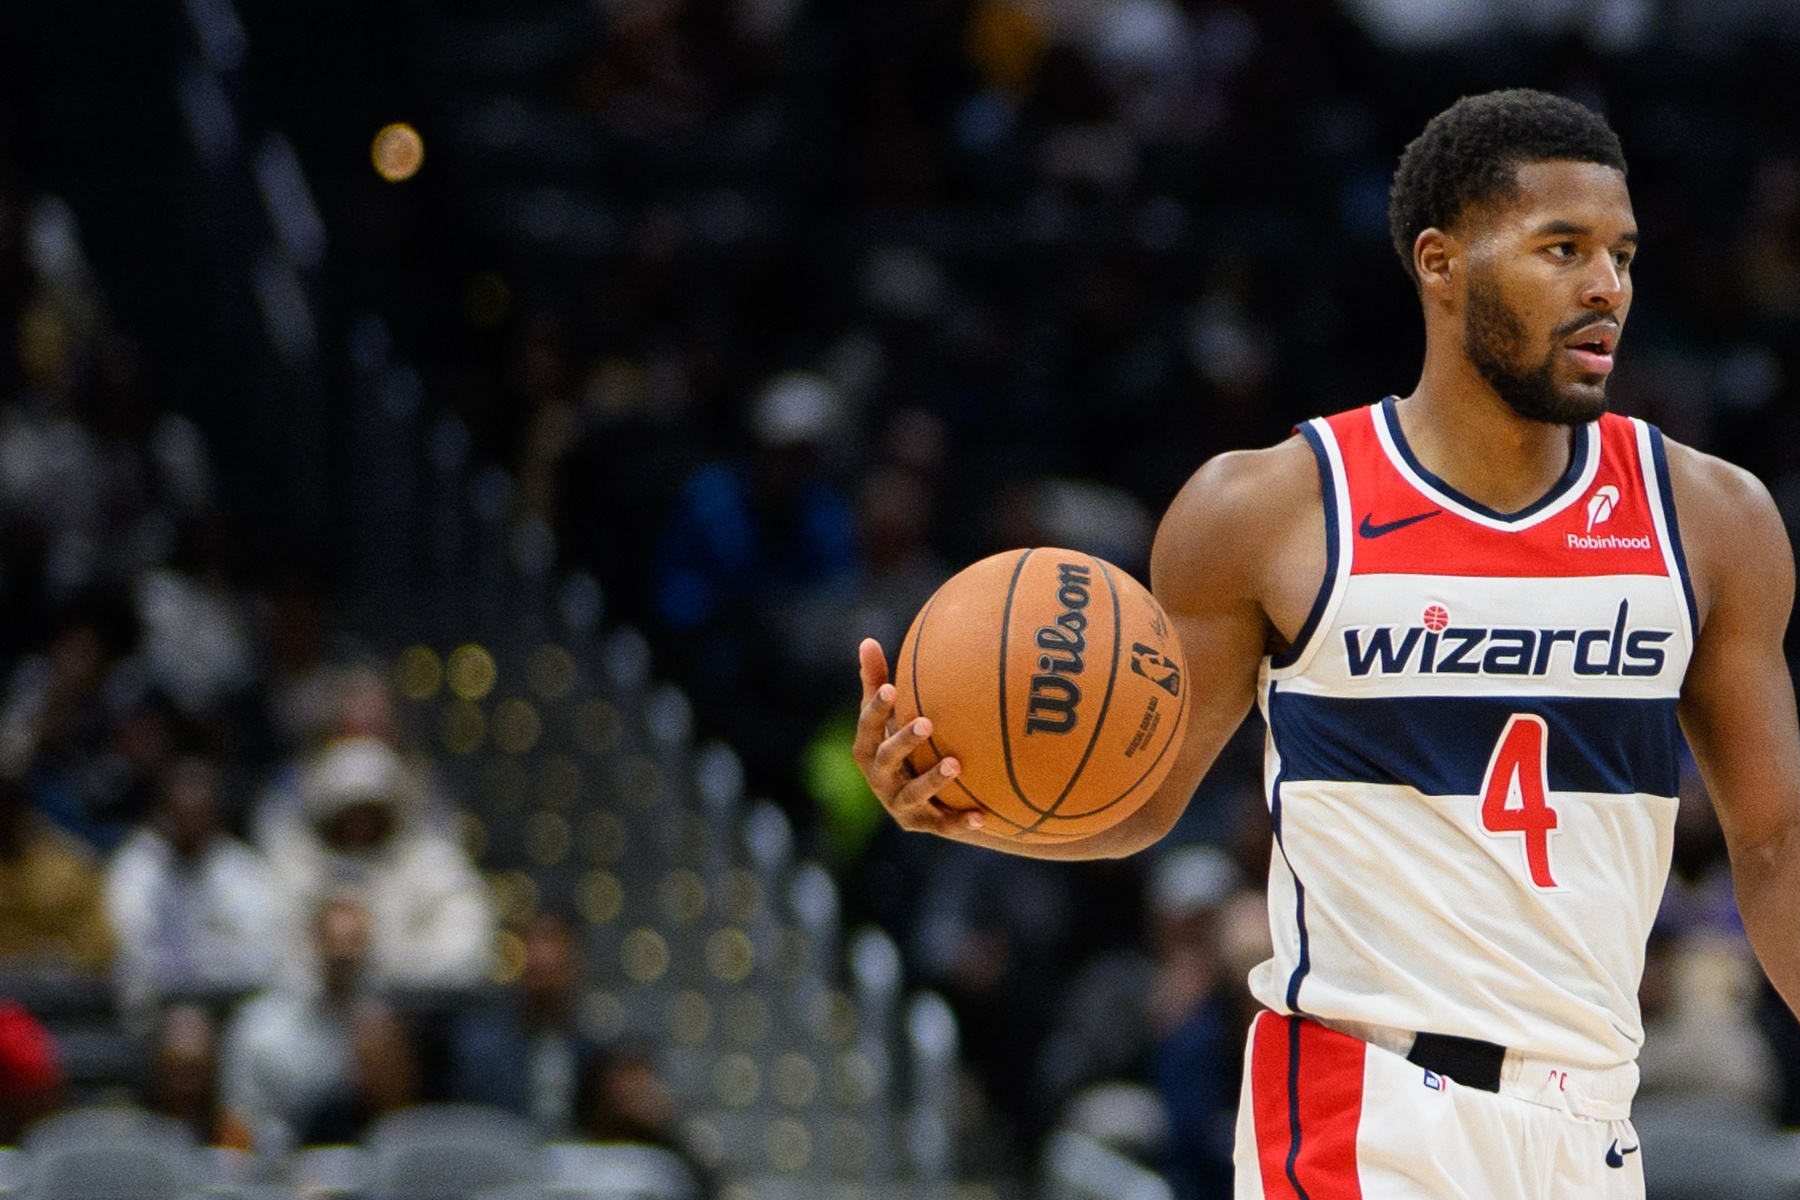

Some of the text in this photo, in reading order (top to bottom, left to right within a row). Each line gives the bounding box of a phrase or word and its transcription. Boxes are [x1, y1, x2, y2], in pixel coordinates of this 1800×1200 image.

[1566, 533, 1652, 550] Robinhood
[1024, 562, 1092, 737] Wilson
[1342, 598, 1675, 678] wizards
[1479, 715, 1562, 892] 4
